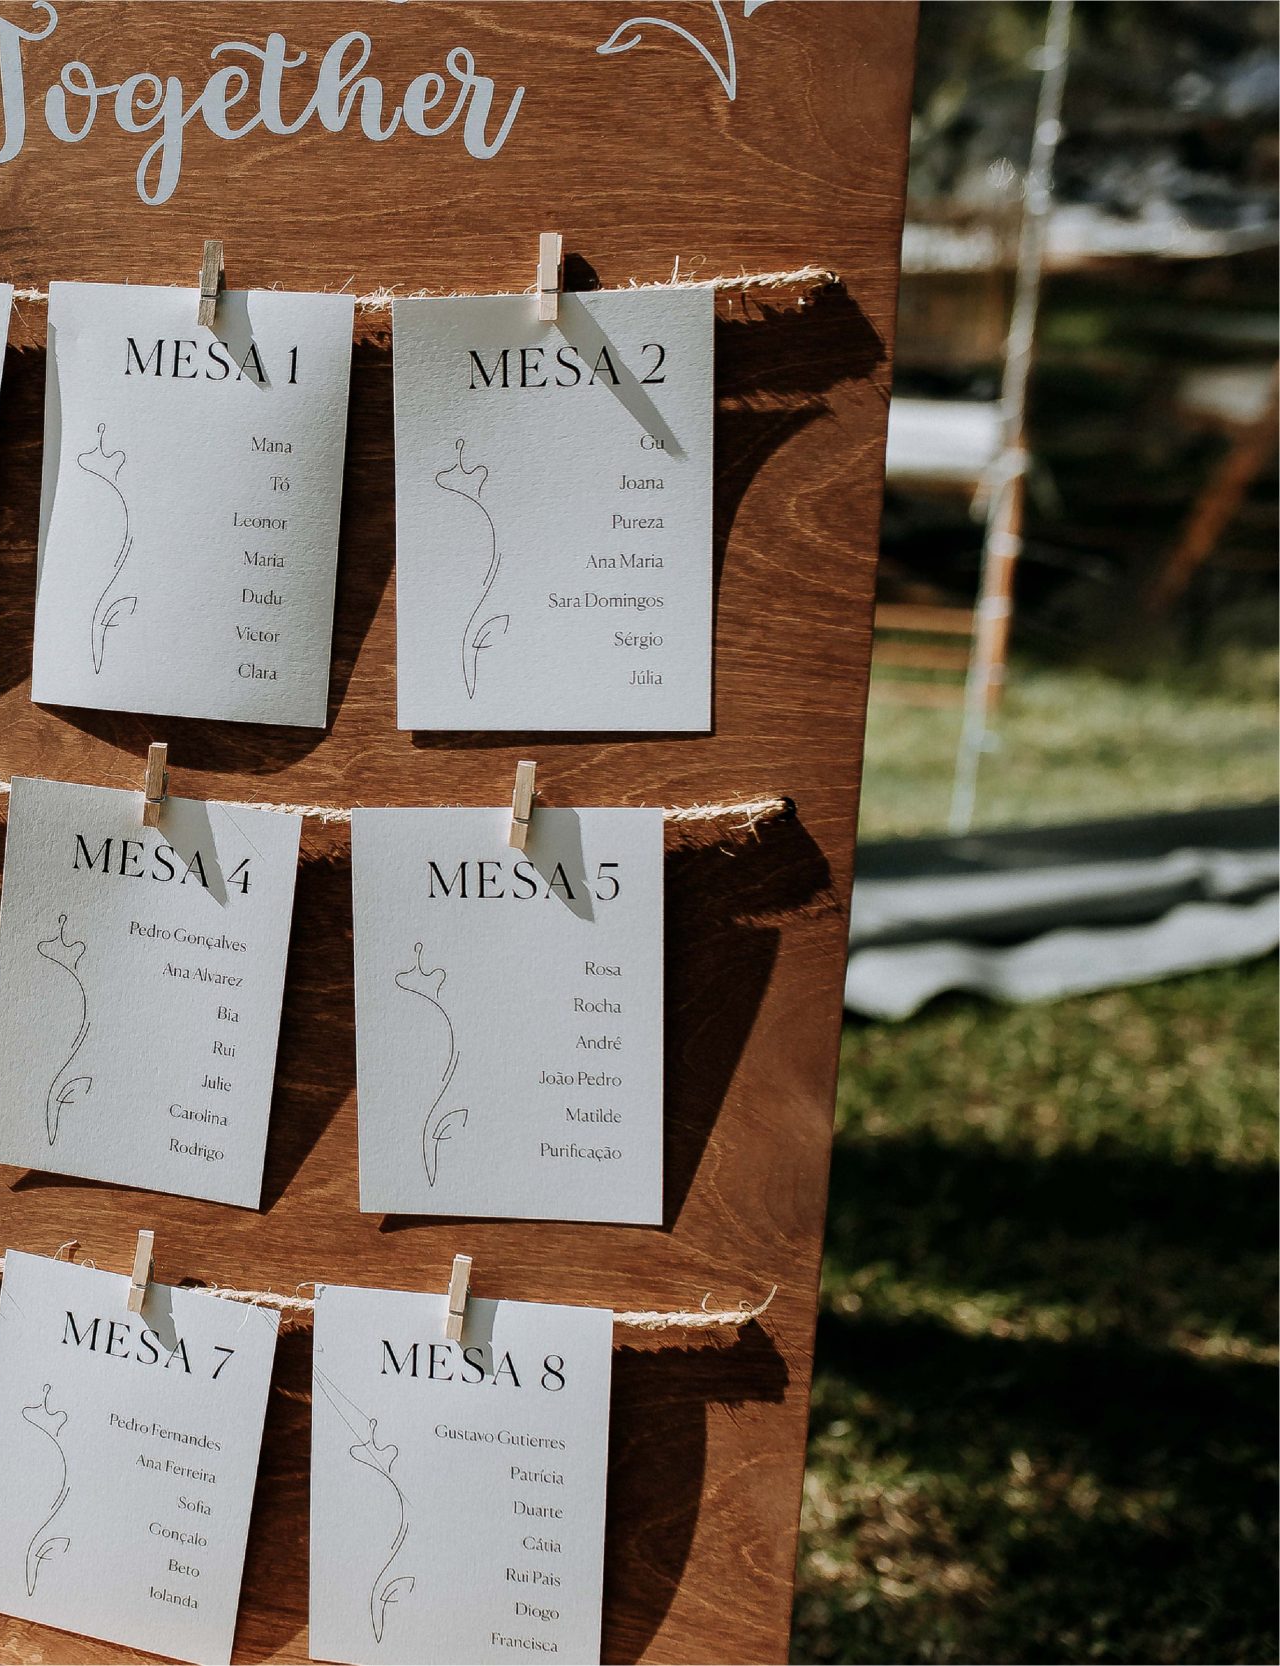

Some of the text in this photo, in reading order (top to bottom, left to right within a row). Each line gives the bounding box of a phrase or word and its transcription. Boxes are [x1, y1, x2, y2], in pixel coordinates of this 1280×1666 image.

[125, 337, 299, 384] MESA 1
[469, 343, 666, 390] MESA 2
[251, 437, 292, 454] Mana
[640, 434, 665, 450] Gu
[270, 476, 289, 492] Tó
[619, 475, 664, 491] Joana
[233, 513, 288, 531] Leonor
[611, 514, 664, 530] Pureza
[243, 551, 284, 568] Maria
[586, 554, 664, 569] Ana Maria
[241, 588, 282, 606] Dudu
[548, 593, 664, 612] Sara Domingos
[236, 626, 280, 643] Victor
[614, 631, 664, 650] Sérgio
[238, 663, 277, 680] Clara
[629, 670, 663, 686] Júlia
[73, 835, 252, 893] MESA 4
[427, 861, 620, 900] MESA 5
[130, 921, 247, 952] Pedro Gonçalves
[162, 963, 244, 987] Ana Alvarez
[584, 961, 621, 976] Rosa
[217, 1006, 239, 1023] Bia
[573, 998, 621, 1014] Rocha
[213, 1041, 236, 1058] Rui
[575, 1036, 621, 1051] André
[201, 1075, 232, 1092] Julie
[539, 1071, 622, 1088] João Pedro
[169, 1104, 228, 1126] Carolina
[565, 1108, 621, 1124] Matilde
[169, 1139, 224, 1161] Rodrigo
[540, 1143, 621, 1162] Purificação
[61, 1311, 236, 1380] MESA 7
[380, 1340, 566, 1392] MESA 8
[109, 1413, 222, 1452] Pedro Fernandes
[434, 1424, 566, 1450] Gustavo Gutierres
[135, 1454, 216, 1484] Ana Ferreira
[510, 1466, 564, 1485] Patrícia
[177, 1496, 212, 1516] Sofia
[513, 1501, 563, 1519] Duarte
[149, 1522, 208, 1547] Gonçalo
[522, 1536, 561, 1554] Cátia
[168, 1559, 200, 1578] Beto
[506, 1568, 561, 1587] Rui Pais
[149, 1586, 199, 1610] Iolanda
[515, 1603, 559, 1621] Diogo
[491, 1632, 558, 1653] Francisca
